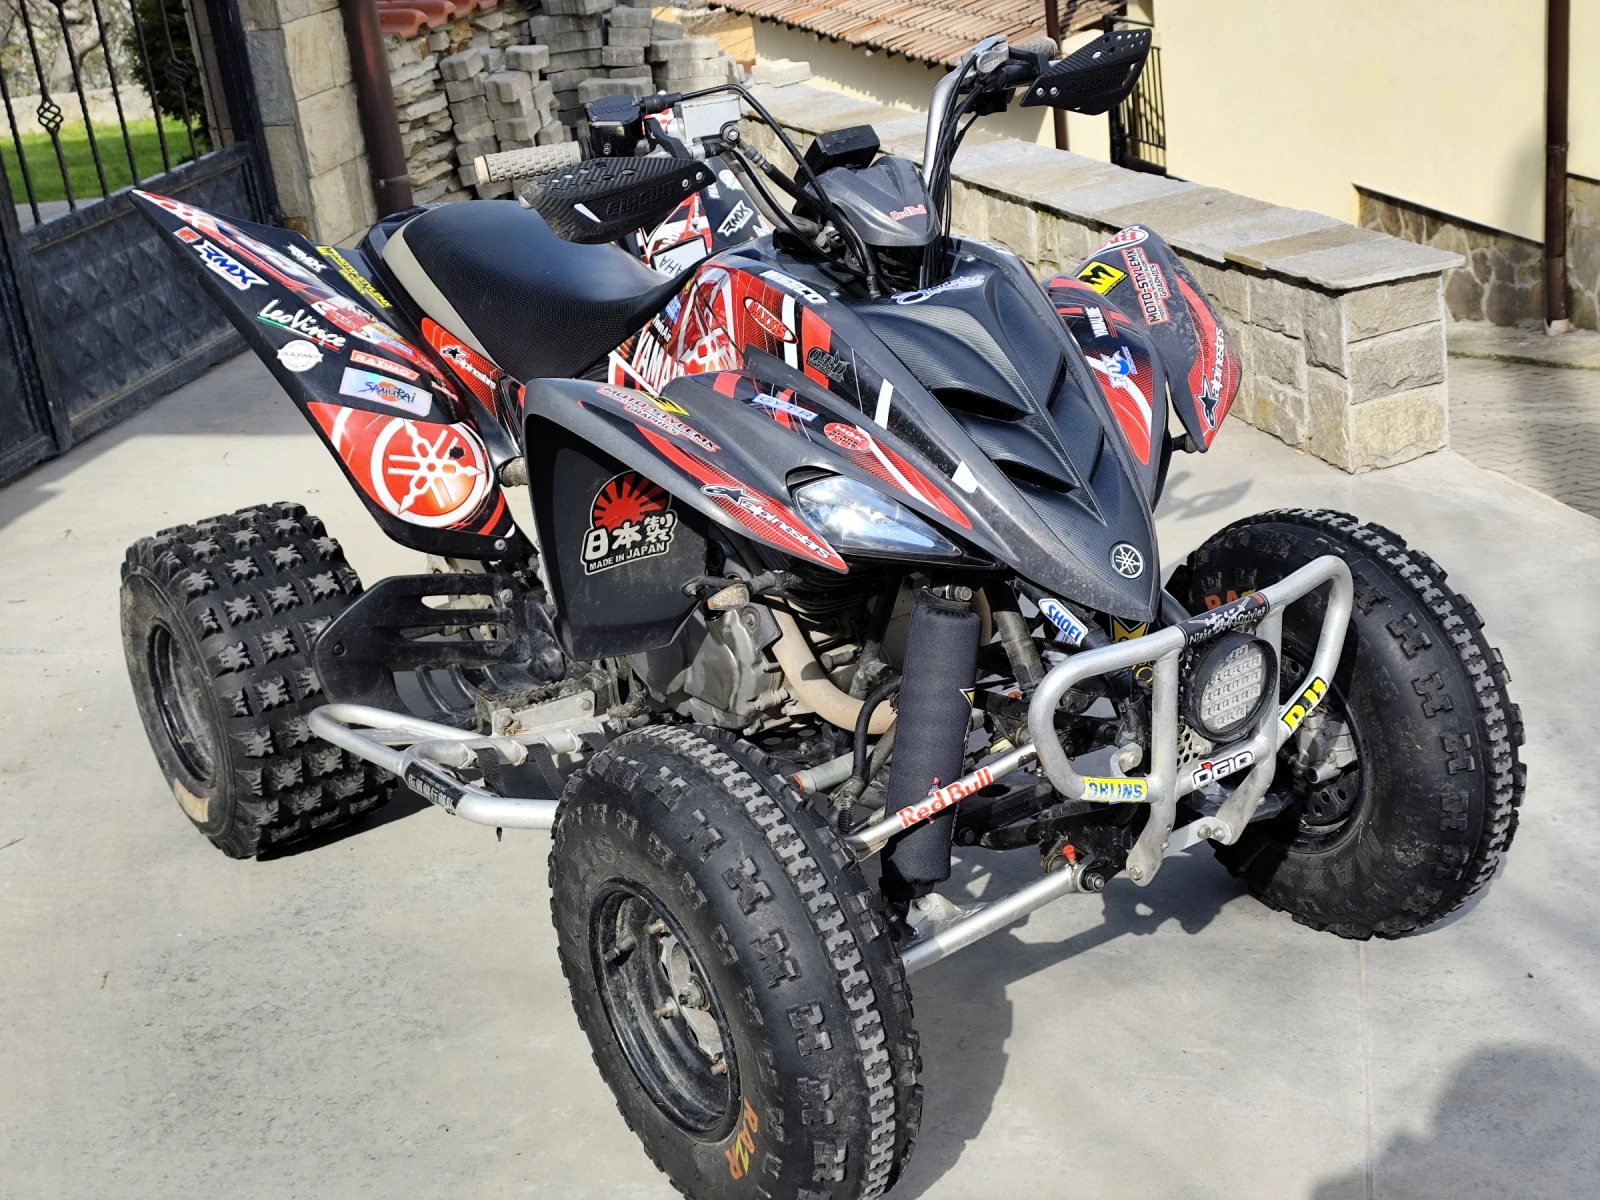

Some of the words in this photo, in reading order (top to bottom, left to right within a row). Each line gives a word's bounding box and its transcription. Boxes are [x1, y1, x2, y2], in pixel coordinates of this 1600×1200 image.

[605, 180, 677, 216] CIRCUIT
[890, 206, 910, 221] Red
[909, 203, 927, 217] Bull
[721, 203, 750, 236] RMX
[202, 244, 260, 286] RMX
[1149, 264, 1167, 297] GRAPHICS
[1125, 248, 1161, 323] MOTO-STYLEMX
[258, 298, 348, 348] LeoVince
[747, 299, 789, 339] MAXXIS
[281, 350, 319, 361] RAXIMO
[354, 353, 411, 378] RAXIMO
[1101, 349, 1129, 388] FOX
[1211, 327, 1226, 398] alpinestars
[627, 404, 679, 434] GRAPHICS
[835, 424, 864, 443] NGK
[584, 513, 674, 561] 日本製
[744, 502, 831, 559] alpinestars
[589, 556, 614, 571] MADE
[615, 553, 625, 563] IN
[626, 541, 665, 559] JAPAN
[1045, 604, 1083, 643] SHOEI
[897, 790, 948, 829] Red
[945, 767, 993, 803] Bull
